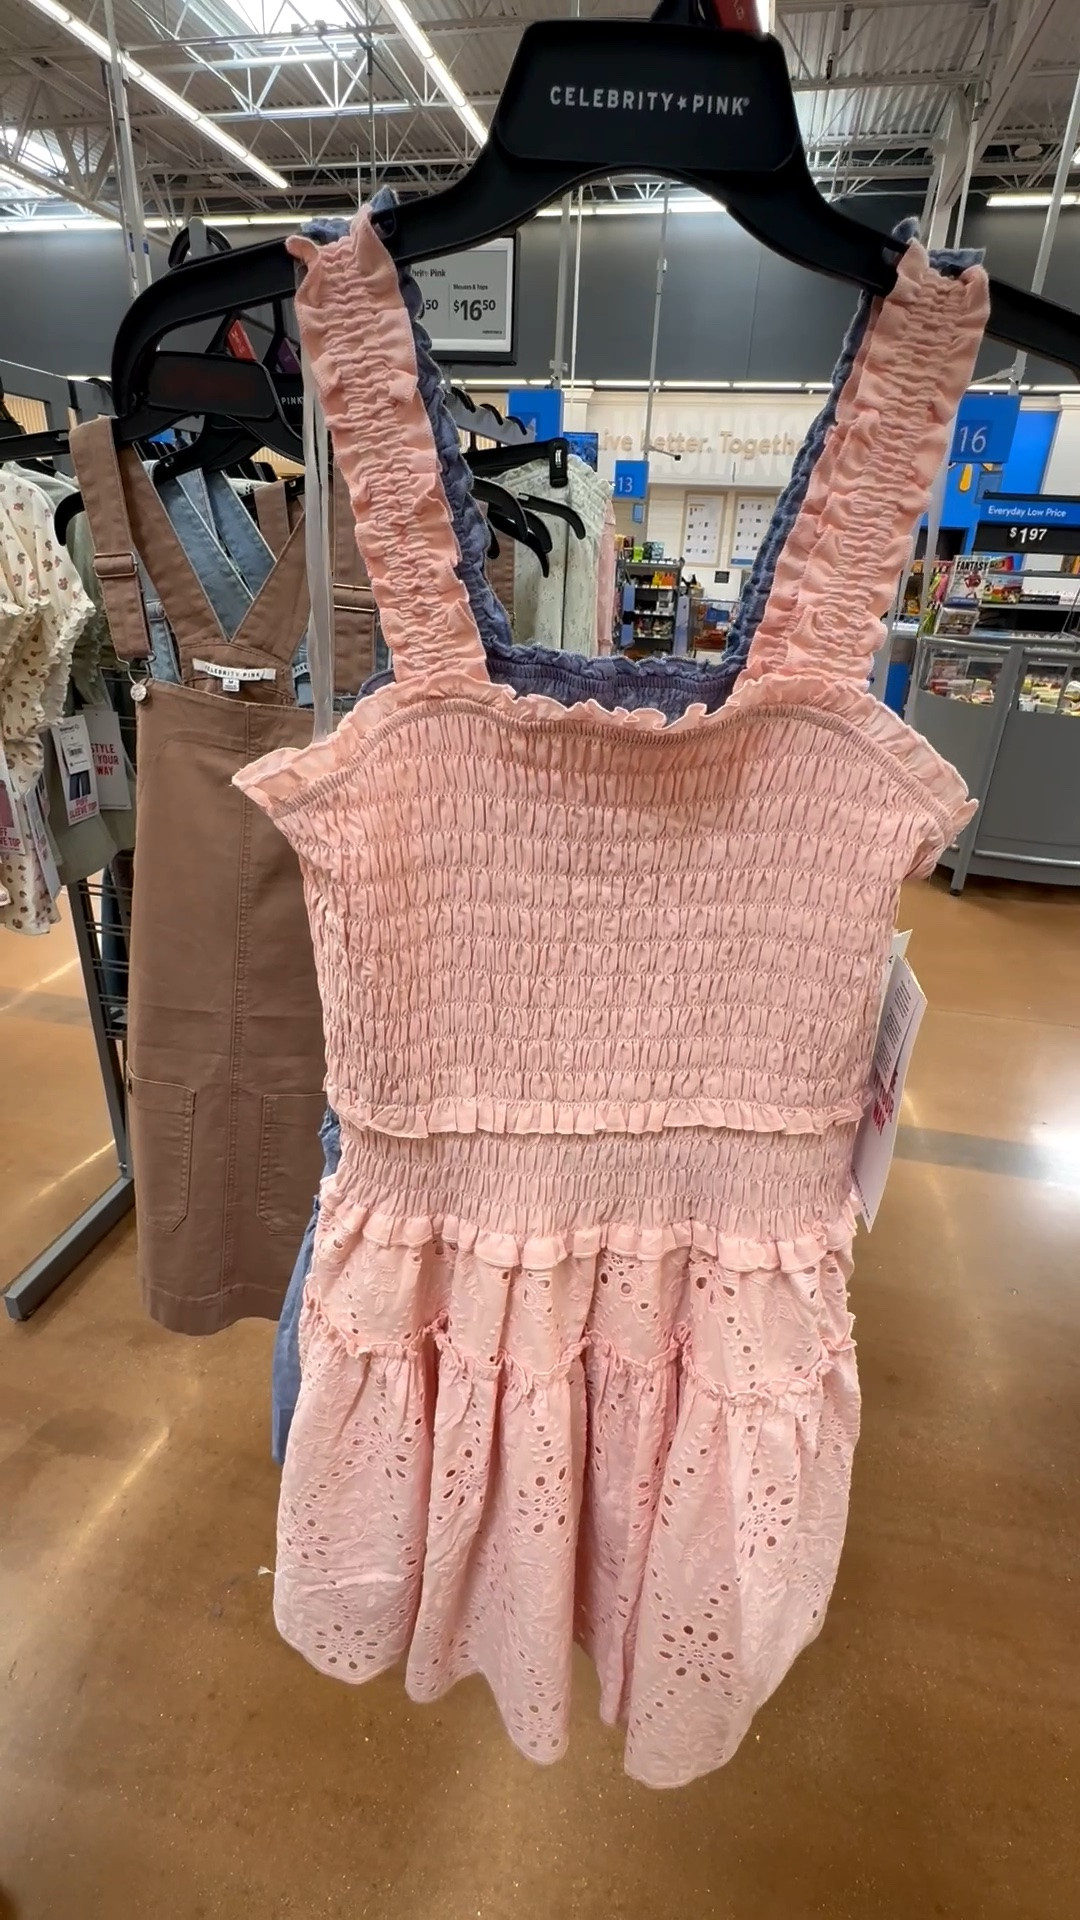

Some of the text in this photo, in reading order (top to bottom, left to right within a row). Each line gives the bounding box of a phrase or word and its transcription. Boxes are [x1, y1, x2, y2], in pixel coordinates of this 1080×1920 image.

[550, 86, 674, 112] CELEBRITY
[430, 268, 446, 277] Pink
[598, 428, 633, 452] ive
[960, 426, 988, 453] 16
[618, 476, 634, 493] 13
[988, 505, 1067, 518] Everyday Low Price
[956, 560, 989, 571] FANTASY
[97, 754, 119, 766] YOUR
[96, 765, 113, 776] WAY
